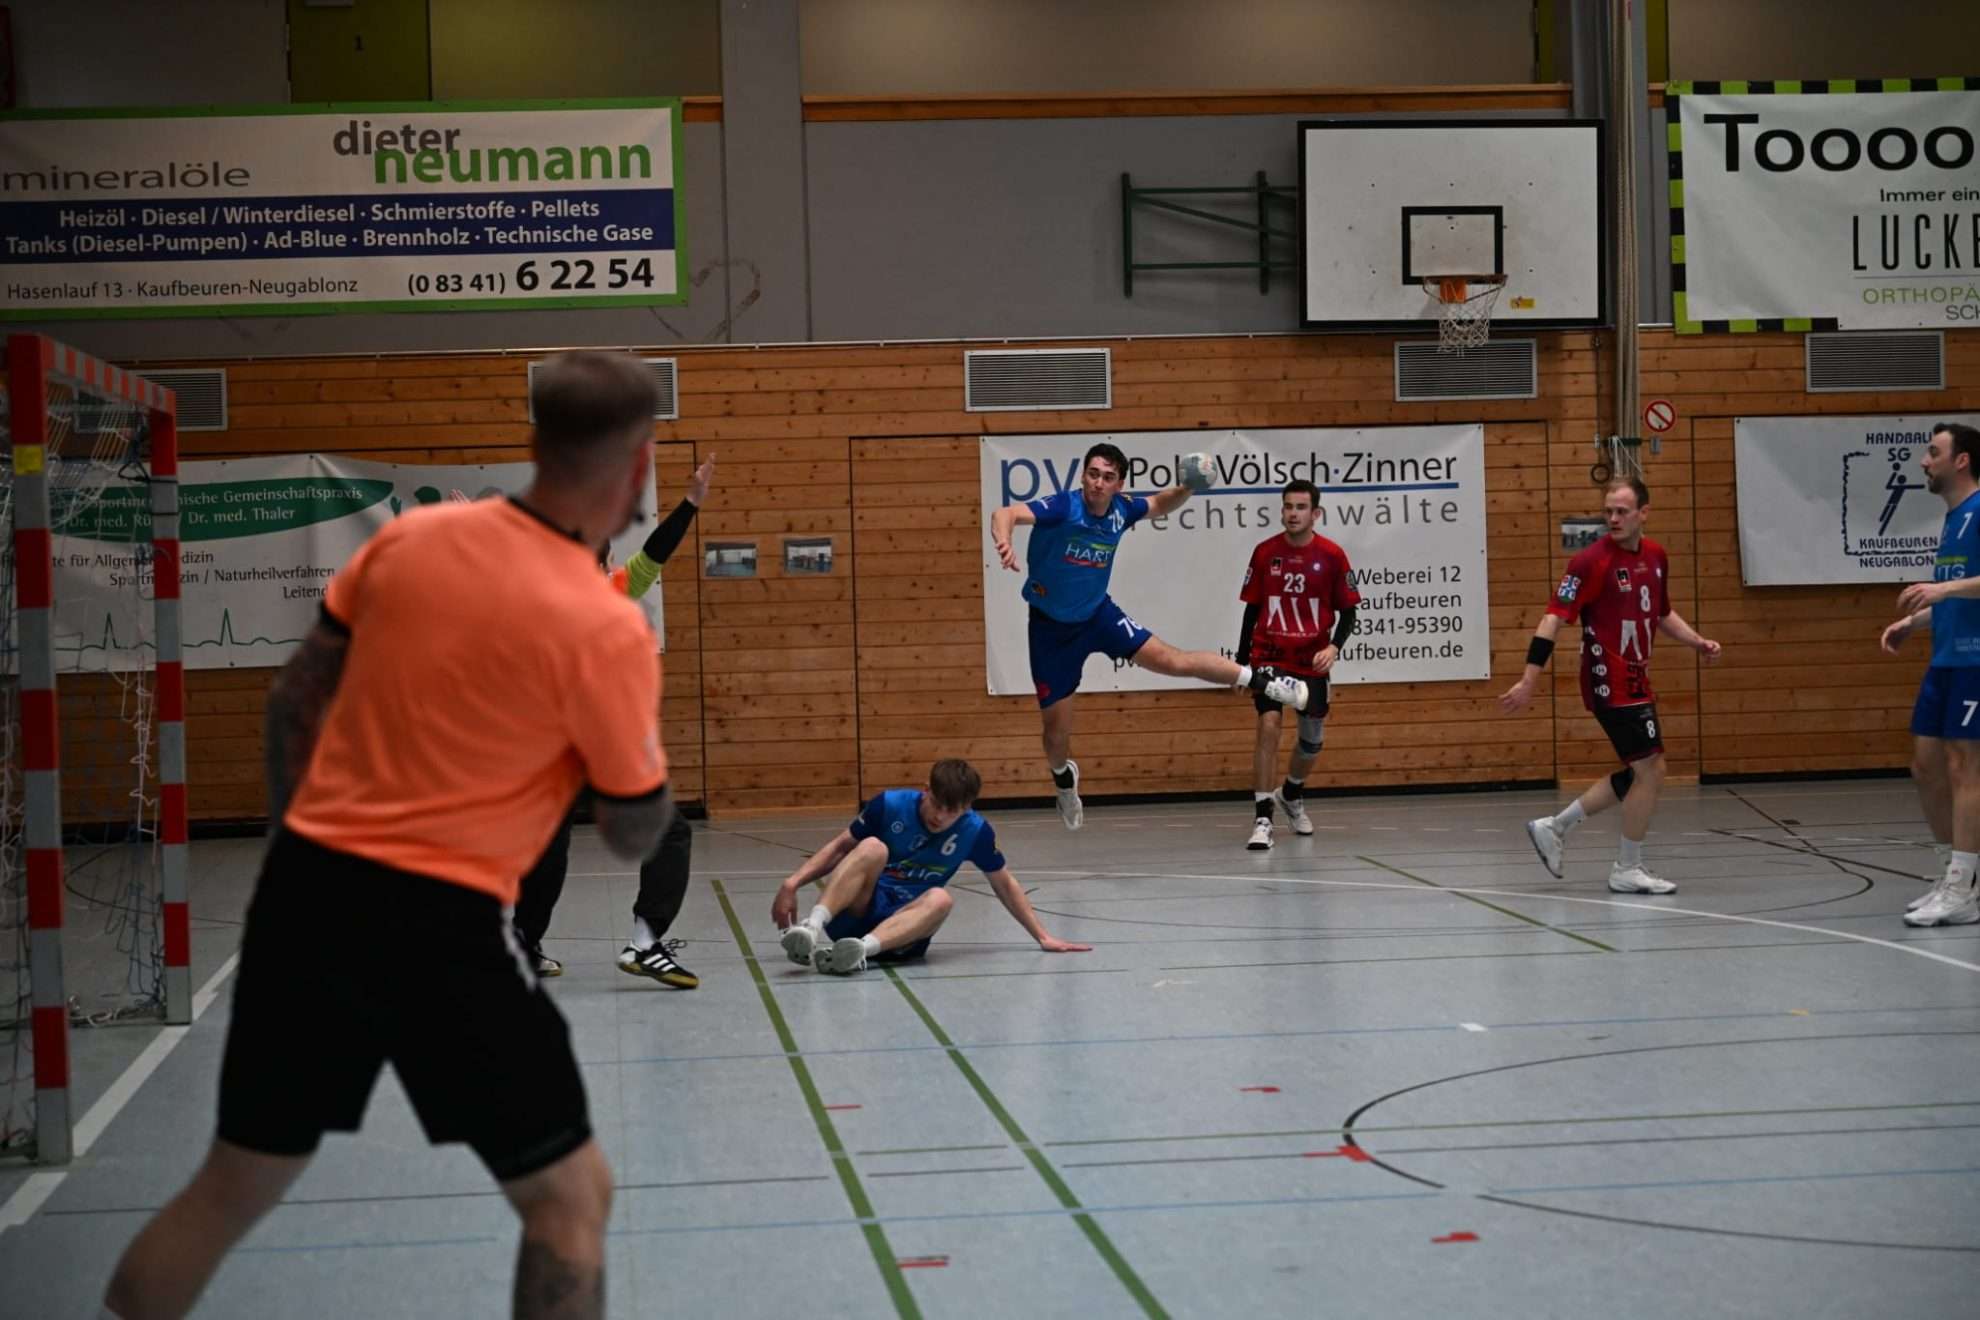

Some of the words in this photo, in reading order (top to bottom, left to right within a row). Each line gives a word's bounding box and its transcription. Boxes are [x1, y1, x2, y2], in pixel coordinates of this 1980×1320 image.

[333, 120, 460, 156] dieter
[1704, 113, 1975, 172] Toooo
[374, 144, 651, 184] neumann
[2, 161, 250, 191] mineralöle
[1880, 188, 1945, 203] Immer
[60, 208, 125, 228] Heizöl
[141, 207, 206, 226] Diesel
[224, 204, 355, 225] Winterdiesel
[371, 201, 516, 221] Schmierstoffe
[532, 199, 600, 218] Pellets
[6, 236, 67, 254] Tanks
[73, 232, 247, 256] (Diesel-Pumpen)
[264, 231, 347, 249] Ad-Blue
[363, 227, 470, 248] Brennholz
[485, 225, 598, 244] Technische
[603, 224, 654, 241] Gase
[408, 273, 429, 294] (0
[436, 274, 463, 293] 83
[469, 272, 506, 294] 41)
[516, 260, 539, 291] 6
[551, 259, 596, 290] 22
[608, 258, 655, 288] 54
[7, 283, 98, 300] Hasenlauf
[104, 282, 123, 297] 13
[137, 276, 358, 297] Kaufbeuren-Neugablonz
[1888, 447, 1912, 461] SG
[224, 486, 363, 504] Gemeinschaftspraxis
[188, 512, 208, 525] Dr.
[214, 509, 247, 523] med.
[253, 507, 295, 521] Thaler
[1860, 536, 1939, 549] KAUFBEUREN
[214, 565, 336, 583] Naturheilverfahren
[1283, 572, 1306, 593] 23
[1440, 565, 1462, 583] 12
[1355, 591, 1462, 610] aufbeuren
[1640, 585, 1651, 612] 8
[1960, 700, 1979, 727] 7
[1646, 719, 1656, 739] 8
[940, 833, 959, 856] 6
